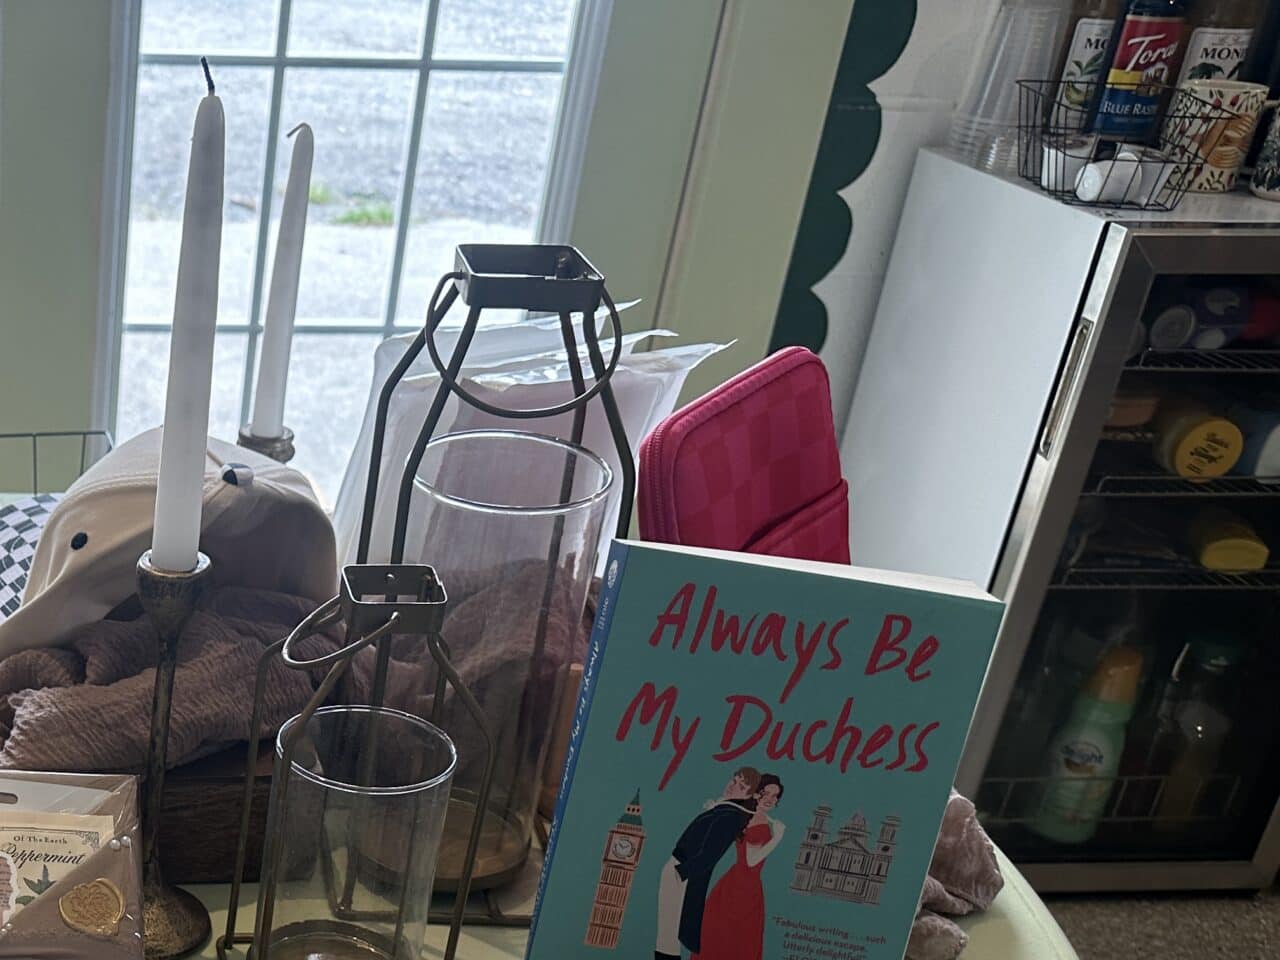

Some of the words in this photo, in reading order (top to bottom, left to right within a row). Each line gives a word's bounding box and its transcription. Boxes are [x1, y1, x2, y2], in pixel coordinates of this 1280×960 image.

[1103, 101, 1130, 114] BLUE
[649, 583, 850, 703] Always
[864, 614, 941, 682] Be
[616, 682, 701, 791] My
[713, 695, 940, 773] Duchess
[4, 842, 86, 869] Peppermint
